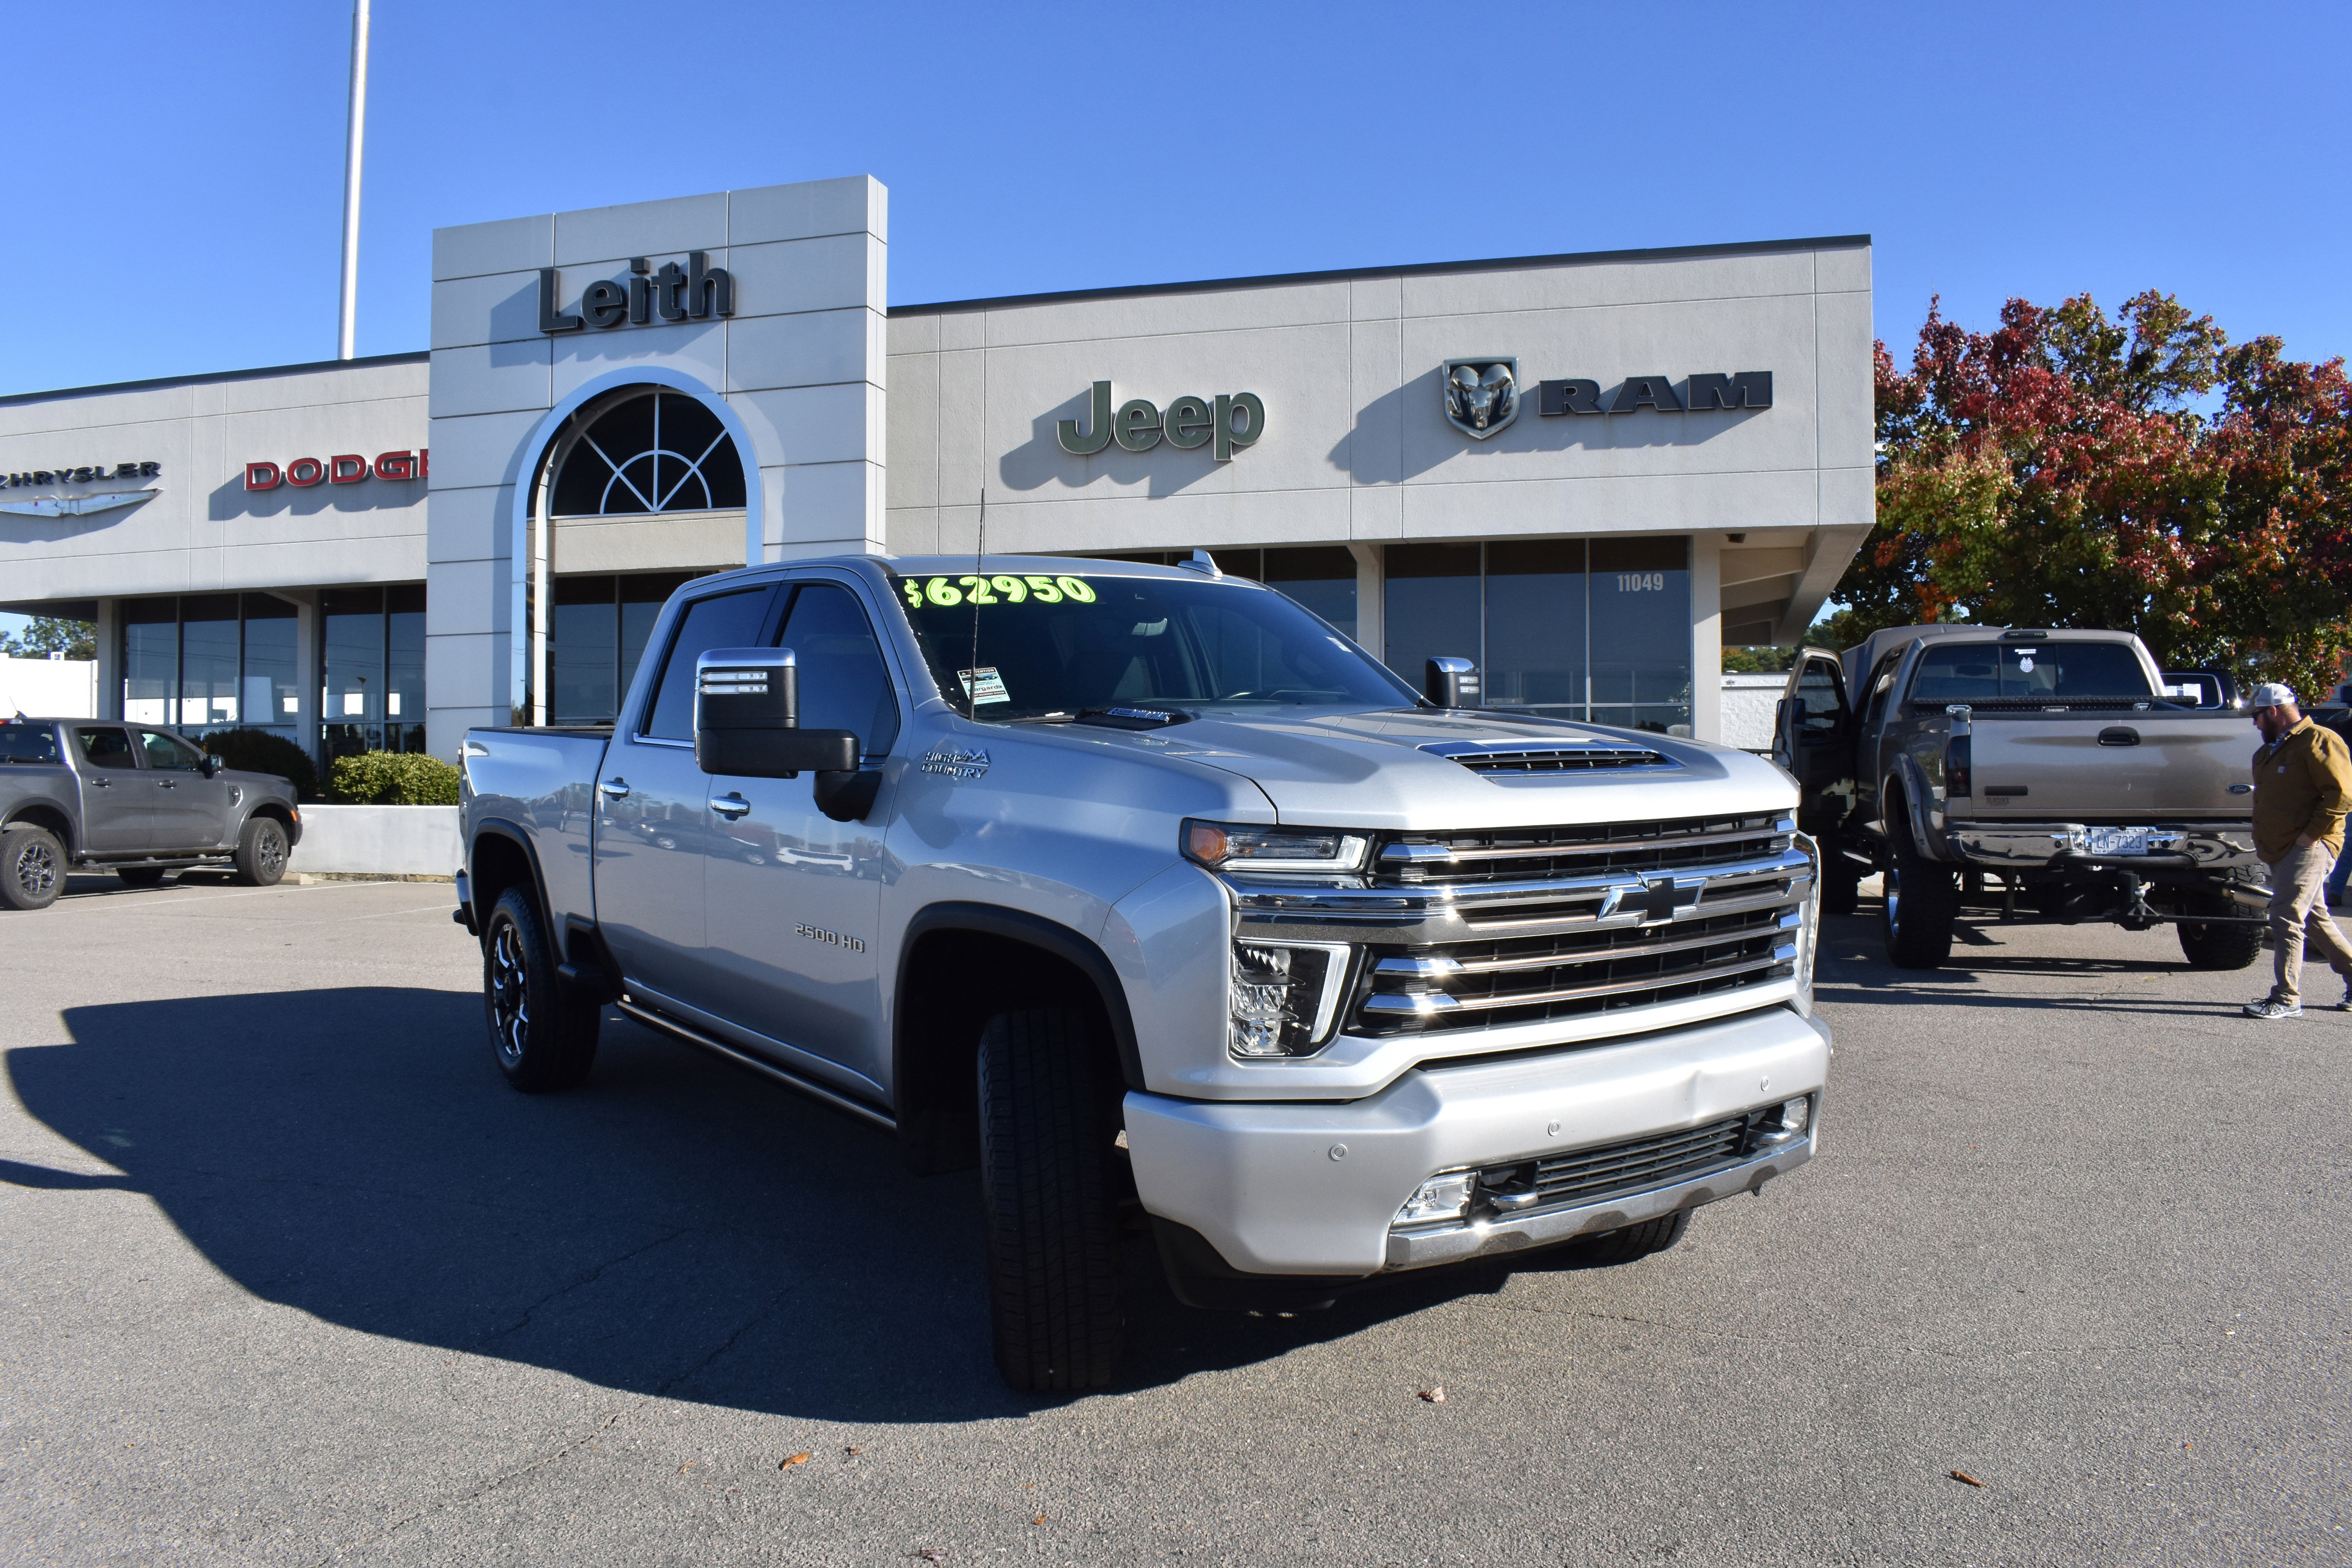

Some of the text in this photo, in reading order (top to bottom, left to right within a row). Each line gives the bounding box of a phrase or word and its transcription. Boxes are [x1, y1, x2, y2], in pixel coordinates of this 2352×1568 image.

[539, 251, 735, 334] Leith
[1539, 371, 1773, 416] RAM
[1057, 380, 1265, 462] Jeep
[904, 575, 1096, 608] $62950
[1617, 573, 1664, 592] 11049
[921, 763, 988, 779] COUNTRY
[925, 752, 957, 763] HIGH
[795, 922, 865, 953] 2500 HD
